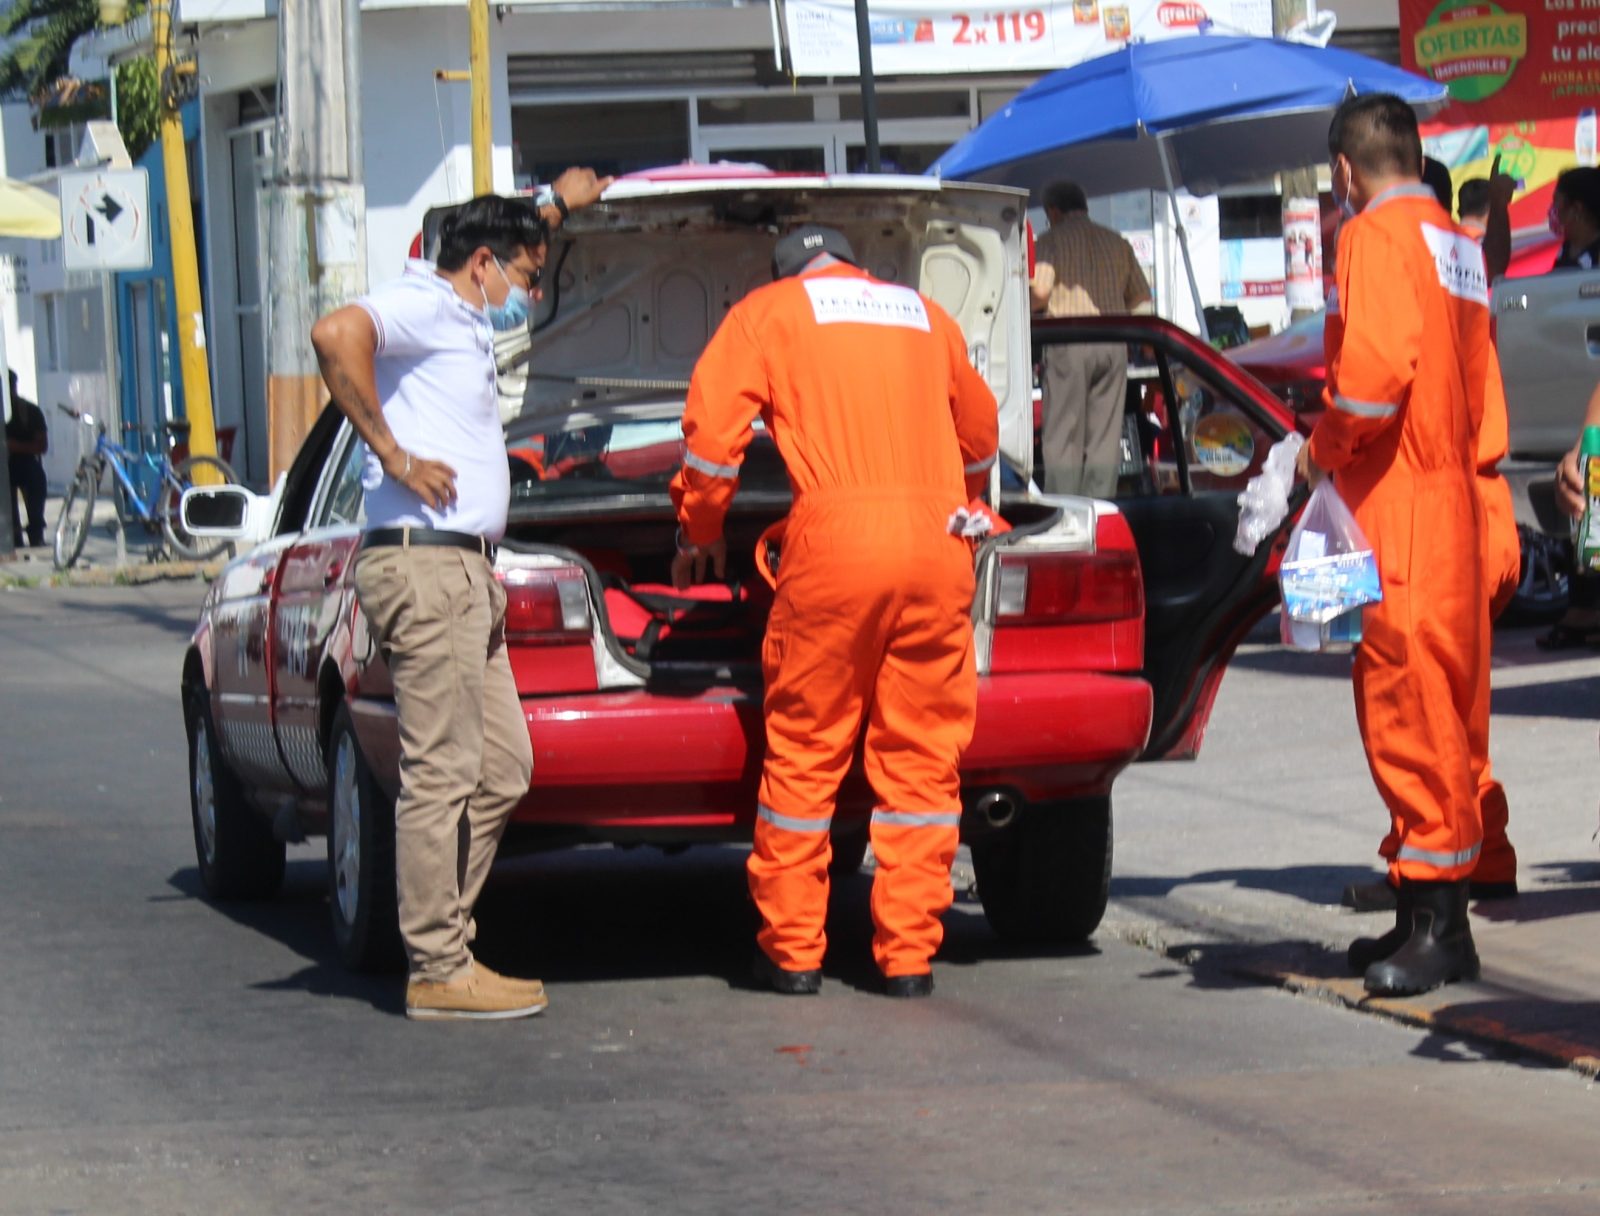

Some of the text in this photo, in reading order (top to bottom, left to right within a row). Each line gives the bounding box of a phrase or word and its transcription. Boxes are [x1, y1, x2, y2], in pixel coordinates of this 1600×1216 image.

[1558, 20, 1600, 41] prec
[1420, 24, 1521, 59] OFERTAS
[1552, 45, 1571, 62] tu
[1434, 58, 1507, 80] IMPERDIBLES
[818, 296, 922, 315] TECNOFIRE
